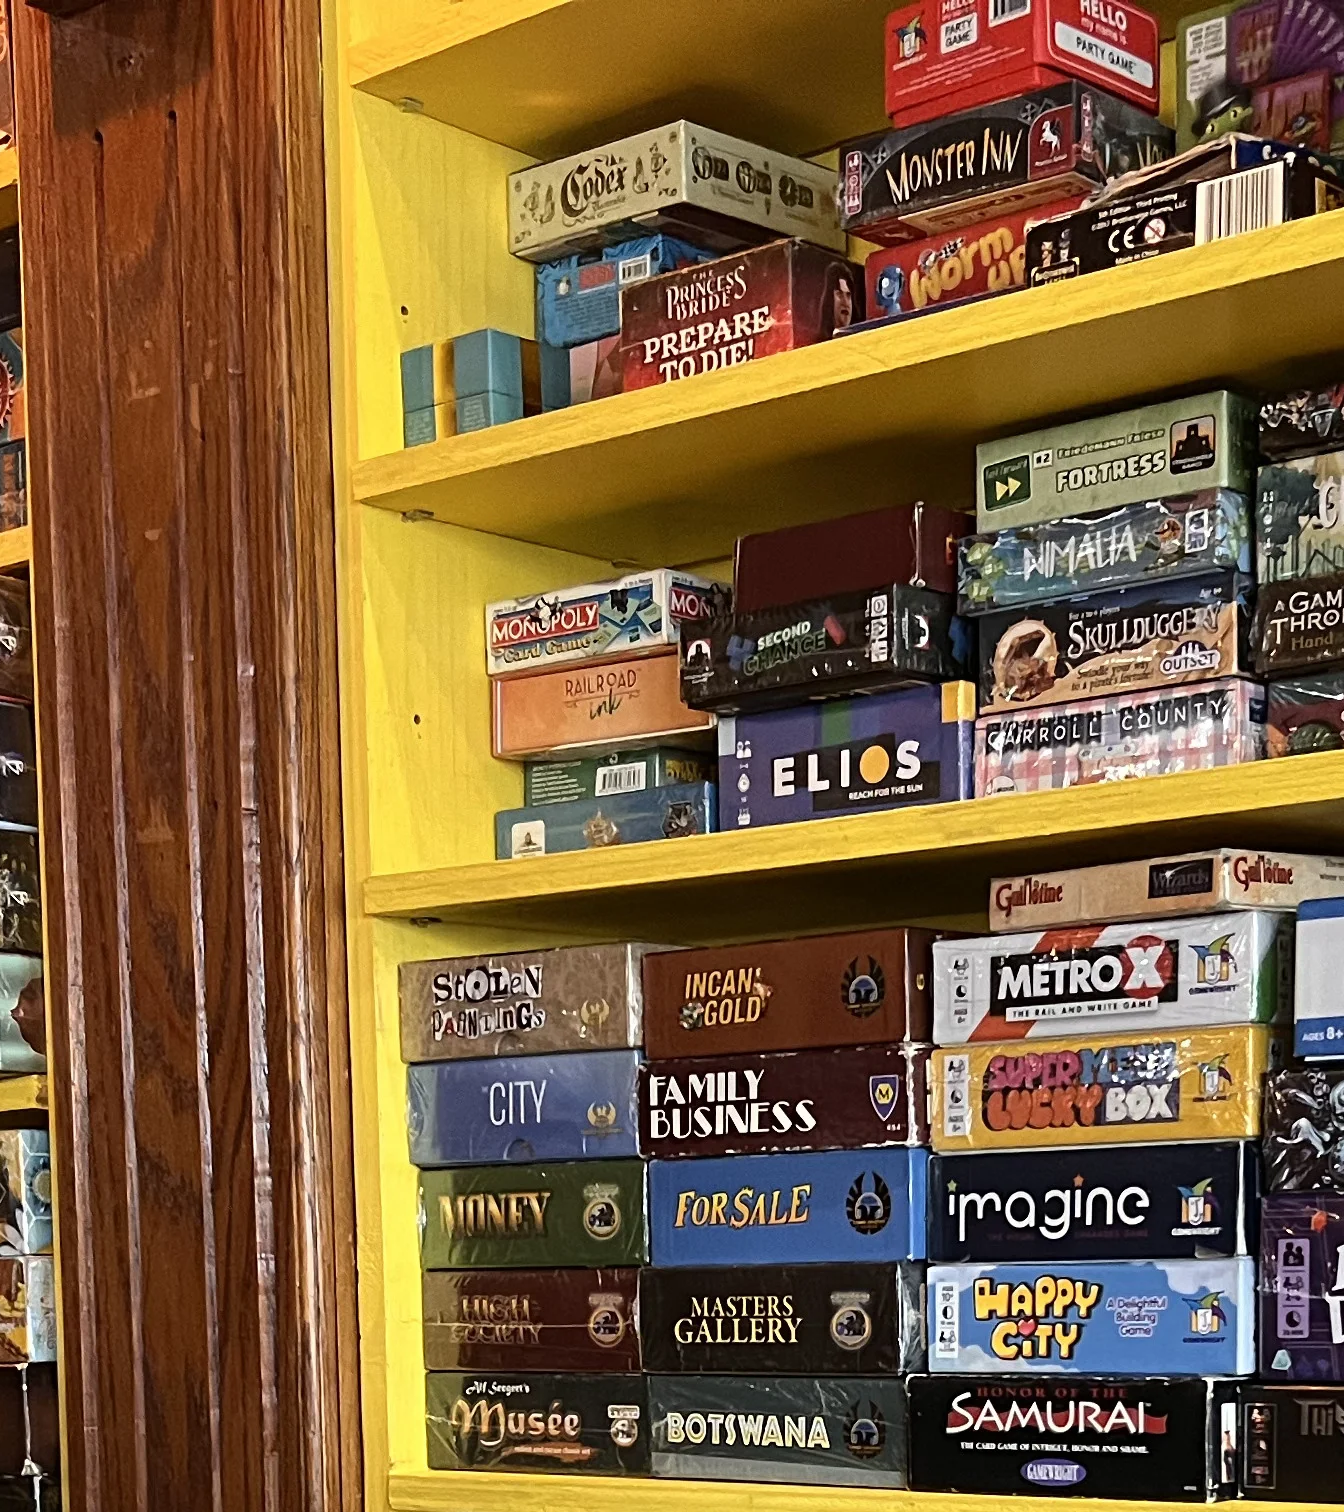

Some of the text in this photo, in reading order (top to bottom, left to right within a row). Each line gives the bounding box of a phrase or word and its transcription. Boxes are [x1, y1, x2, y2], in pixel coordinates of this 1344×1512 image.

[942, 18, 973, 39] PARTY
[945, 30, 973, 50] GAME
[1075, 36, 1137, 76] PARTY GAME
[886, 126, 1023, 204] MONSTER INN
[675, 289, 732, 321] BRIDE
[643, 305, 772, 364] PREPARE
[1056, 450, 1167, 494] FORTRESS
[1273, 599, 1287, 613] A
[503, 633, 593, 664] Card Game
[757, 619, 812, 650] SECOND
[564, 669, 637, 696] RAILROAD
[588, 688, 622, 720] ink
[986, 699, 1223, 748] CARROLL COUNTY
[773, 740, 922, 798] ELIOS
[704, 996, 763, 1027] GOLD
[489, 1080, 547, 1126] CITY
[649, 1068, 765, 1106] FAMILY
[650, 1100, 817, 1139] BUSINESS
[438, 1191, 551, 1238] MONEY
[948, 1178, 1151, 1241] imagine
[690, 1295, 794, 1318] MASTERS
[973, 1276, 1102, 1320] HAPPY
[674, 1316, 803, 1345] GALLERY
[666, 1411, 831, 1450] BOTSWANA
[945, 1391, 1146, 1435] SAMURAI
